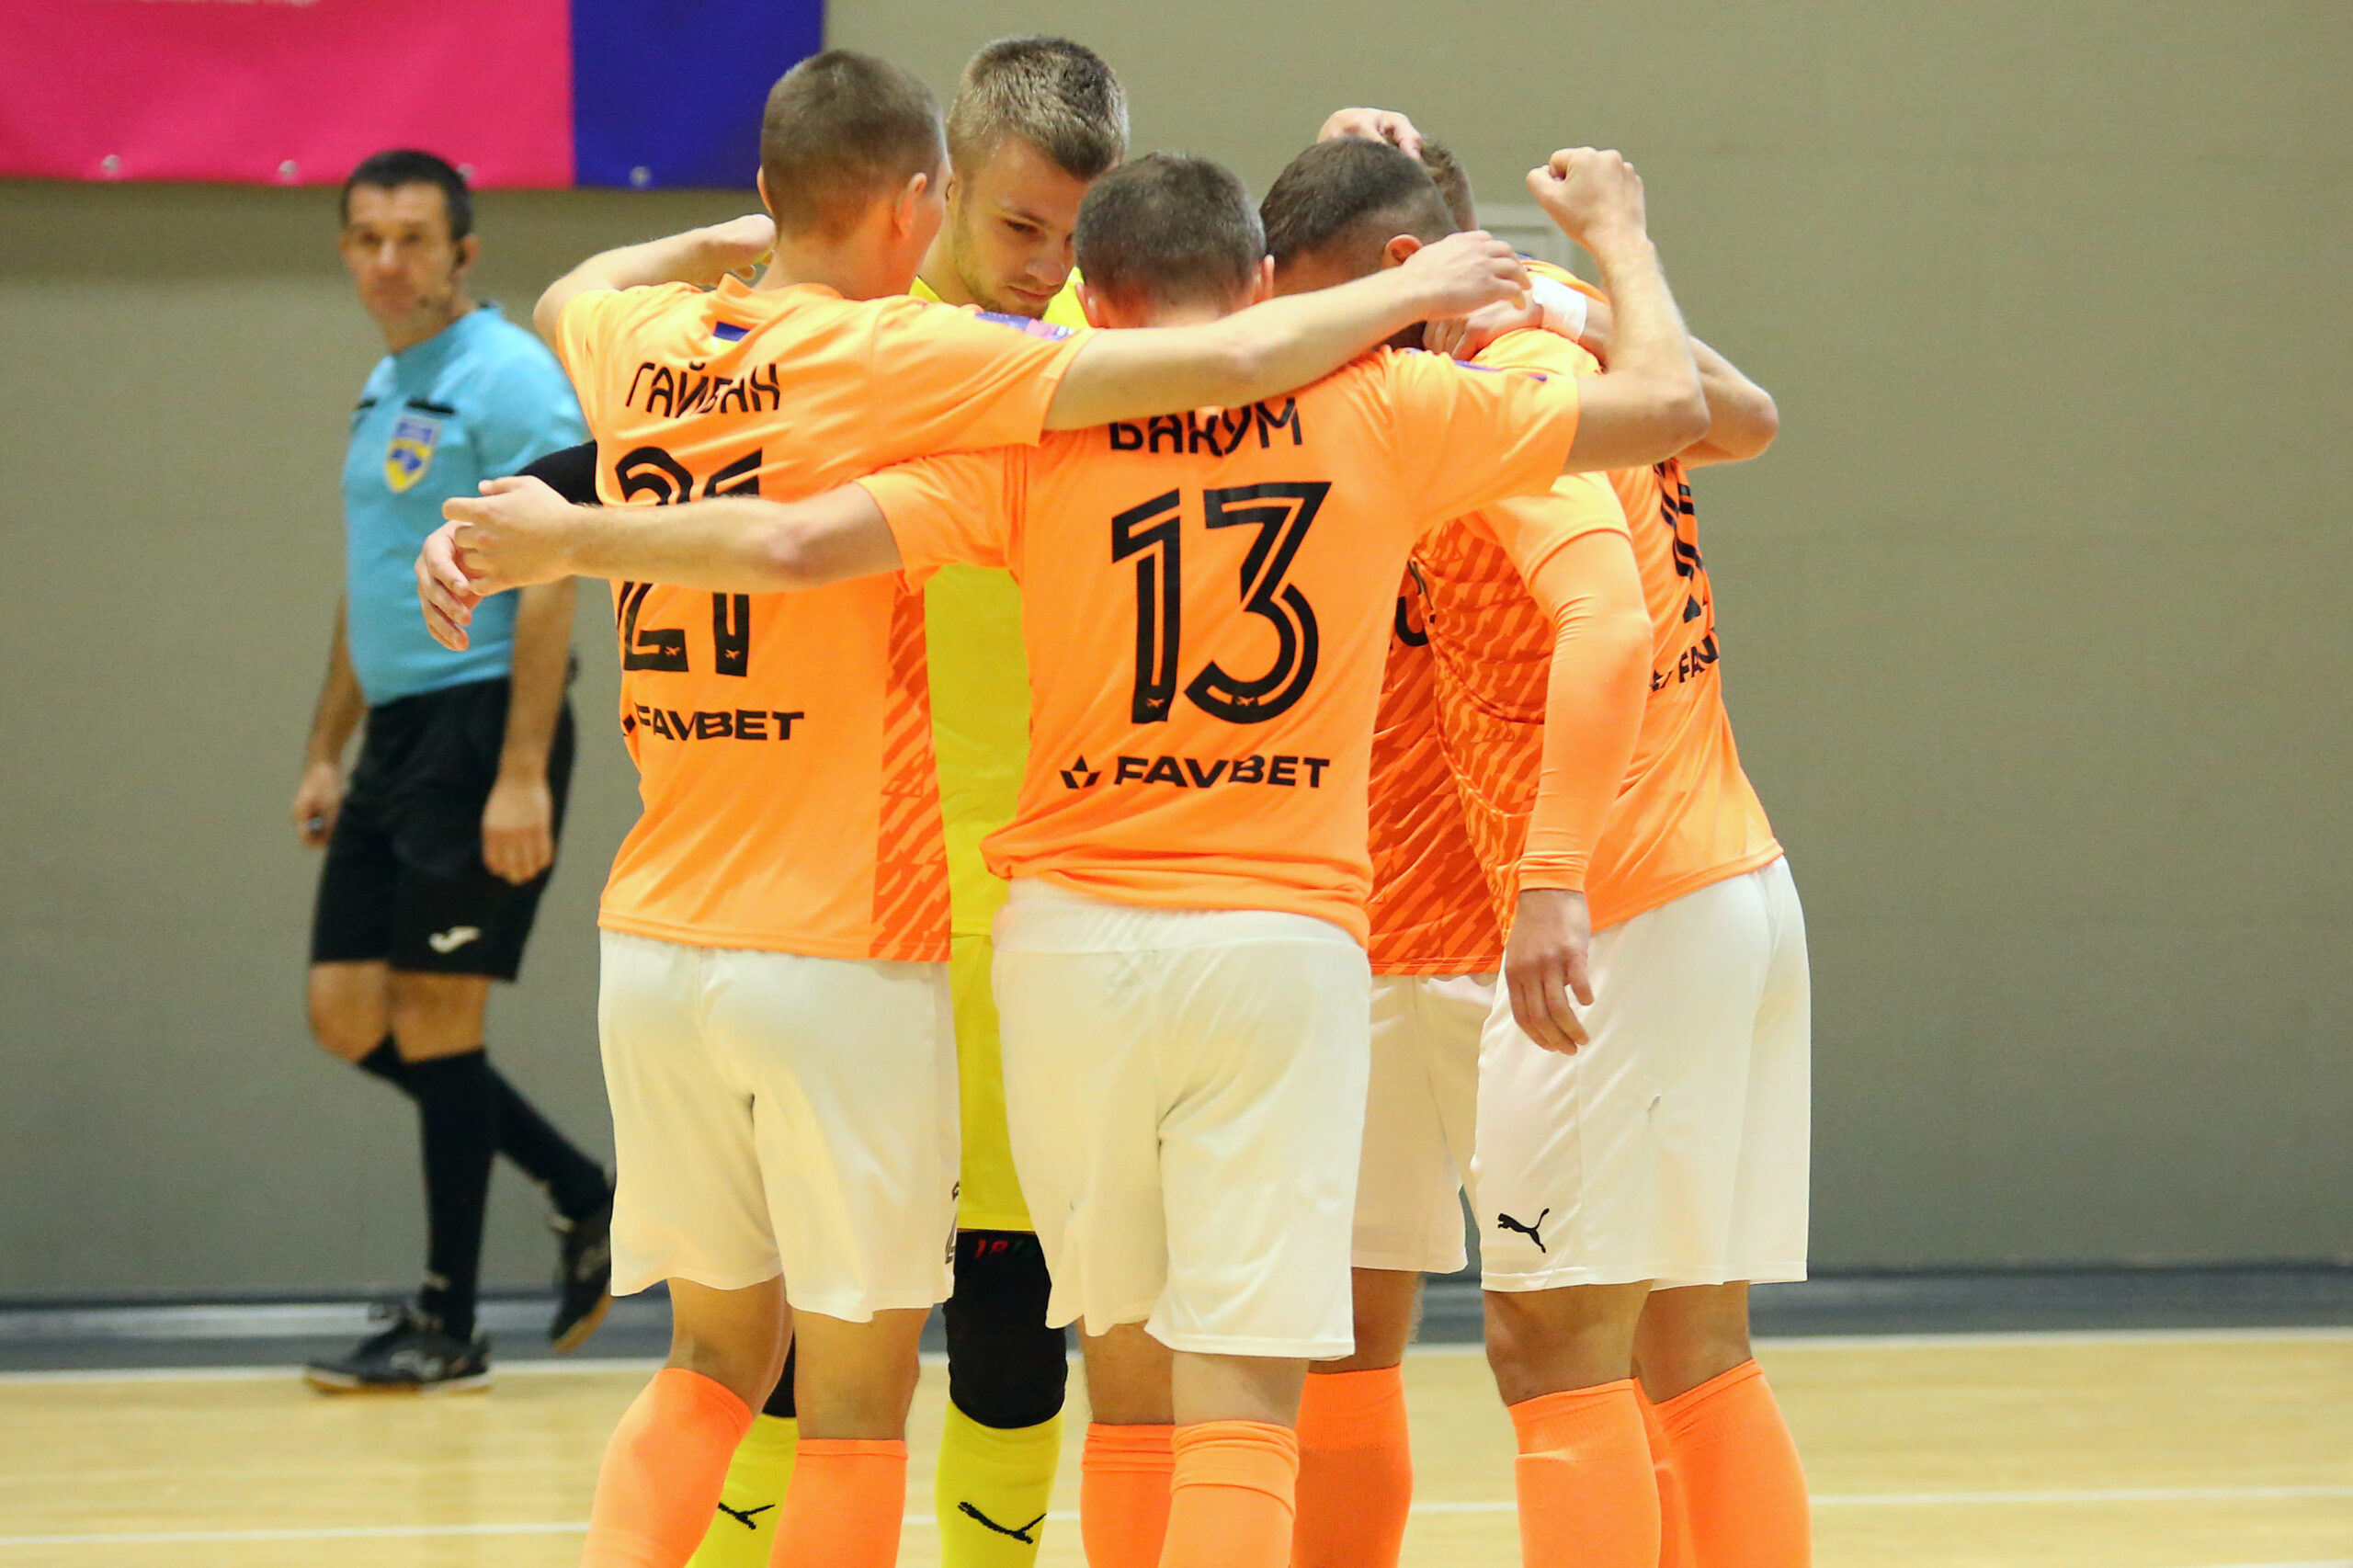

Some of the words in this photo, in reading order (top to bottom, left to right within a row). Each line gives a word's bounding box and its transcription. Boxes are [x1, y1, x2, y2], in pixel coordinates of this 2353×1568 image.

[1111, 481, 1332, 724] 13
[634, 702, 805, 741] FAVBET
[1114, 755, 1330, 789] FAVBET
